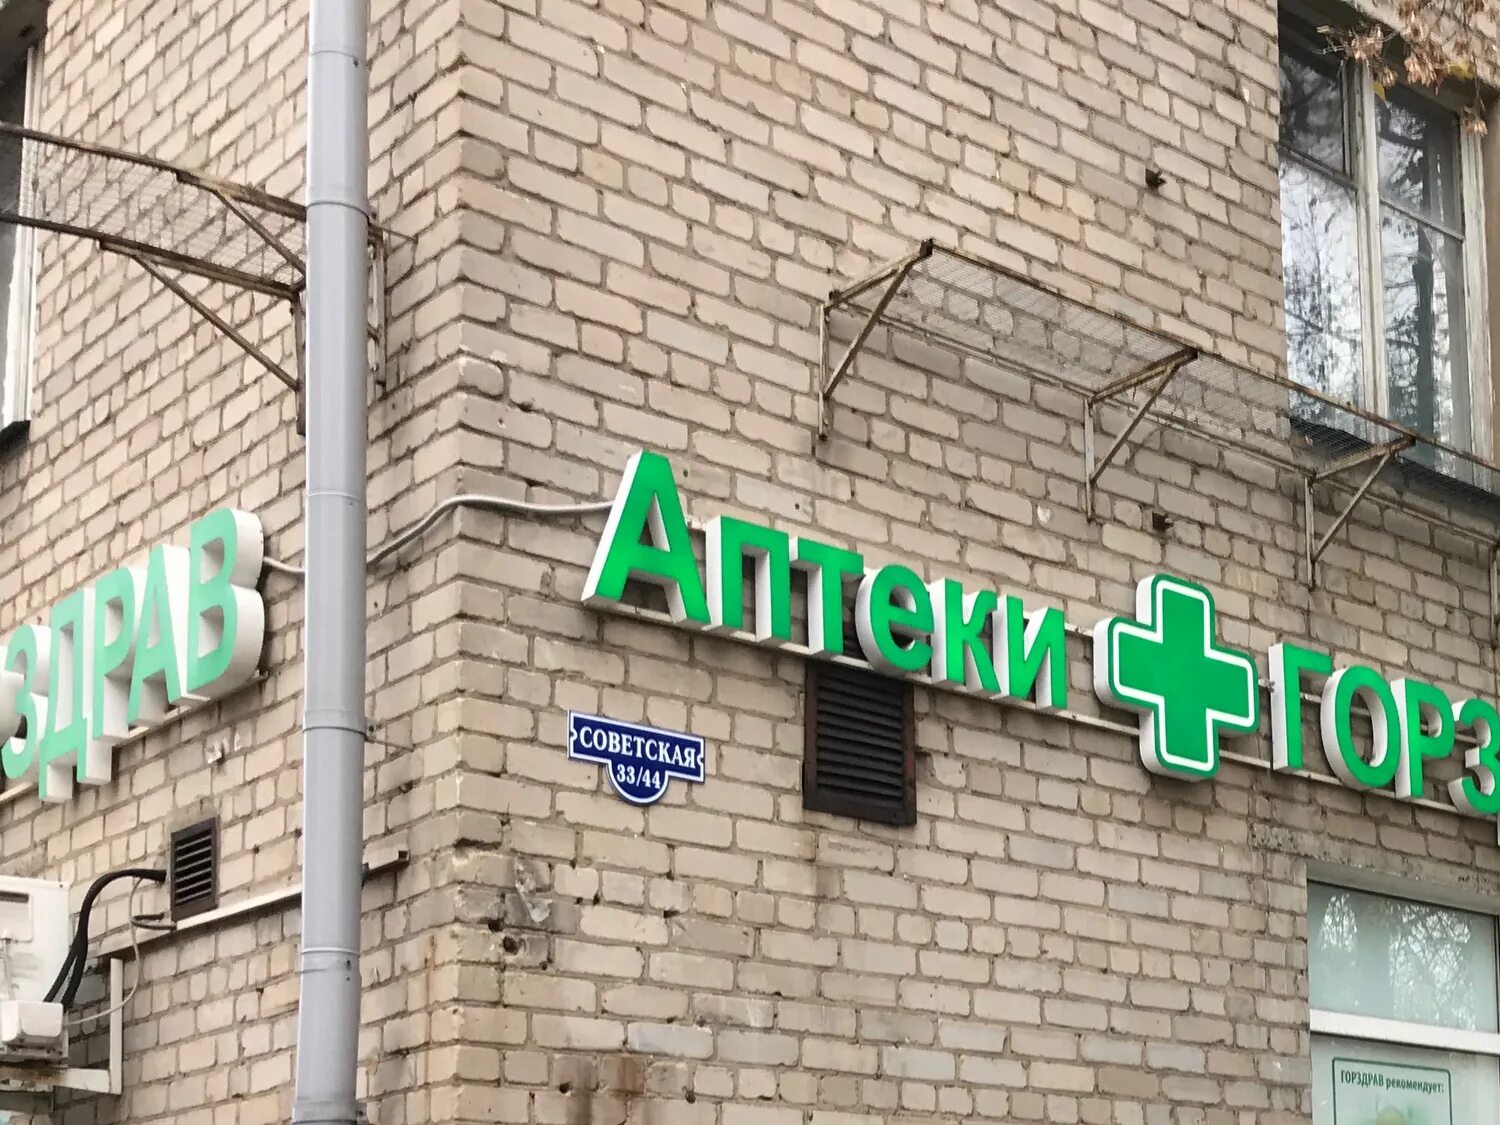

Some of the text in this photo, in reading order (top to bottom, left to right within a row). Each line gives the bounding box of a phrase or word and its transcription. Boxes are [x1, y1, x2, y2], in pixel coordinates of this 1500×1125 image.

[582, 449, 1067, 710] Аптеки
[579, 726, 697, 769] СОВЕТСКАЯ
[616, 763, 661, 790] 33/44
[1341, 1070, 1444, 1095] ГОРЗДРАВ рекомендует:
